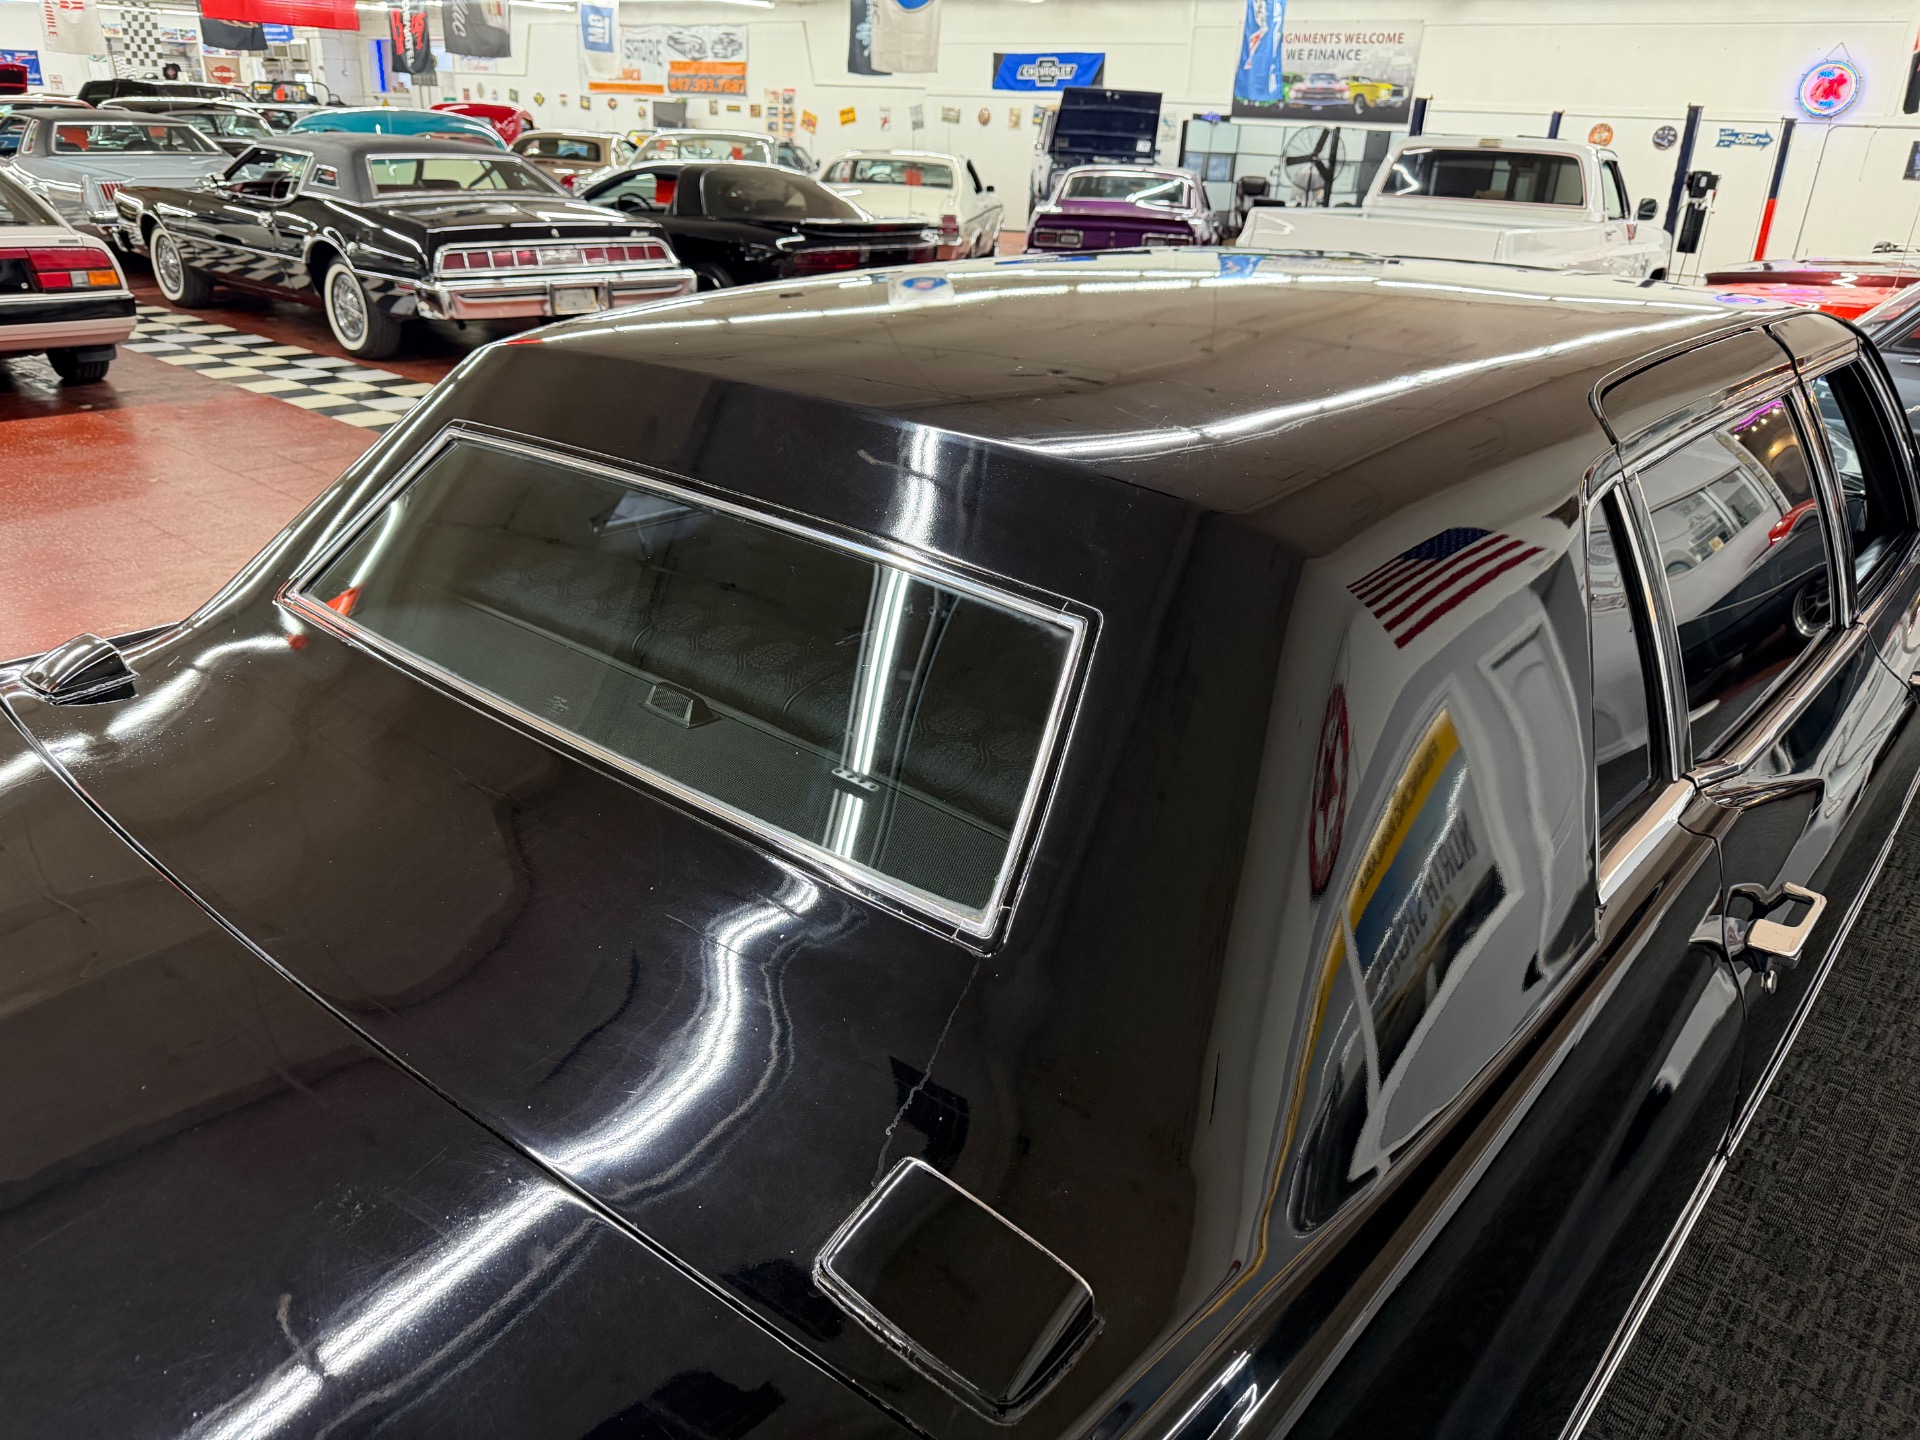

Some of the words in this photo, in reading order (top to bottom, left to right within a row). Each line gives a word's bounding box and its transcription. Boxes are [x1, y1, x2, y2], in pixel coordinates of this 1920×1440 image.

[1344, 32, 1405, 45] WELCOME
[1285, 48, 1305, 61] WE
[1306, 48, 1363, 61] FINANCE
[1020, 65, 1074, 77] CHEVROLET
[1735, 132, 1761, 145] Ford
